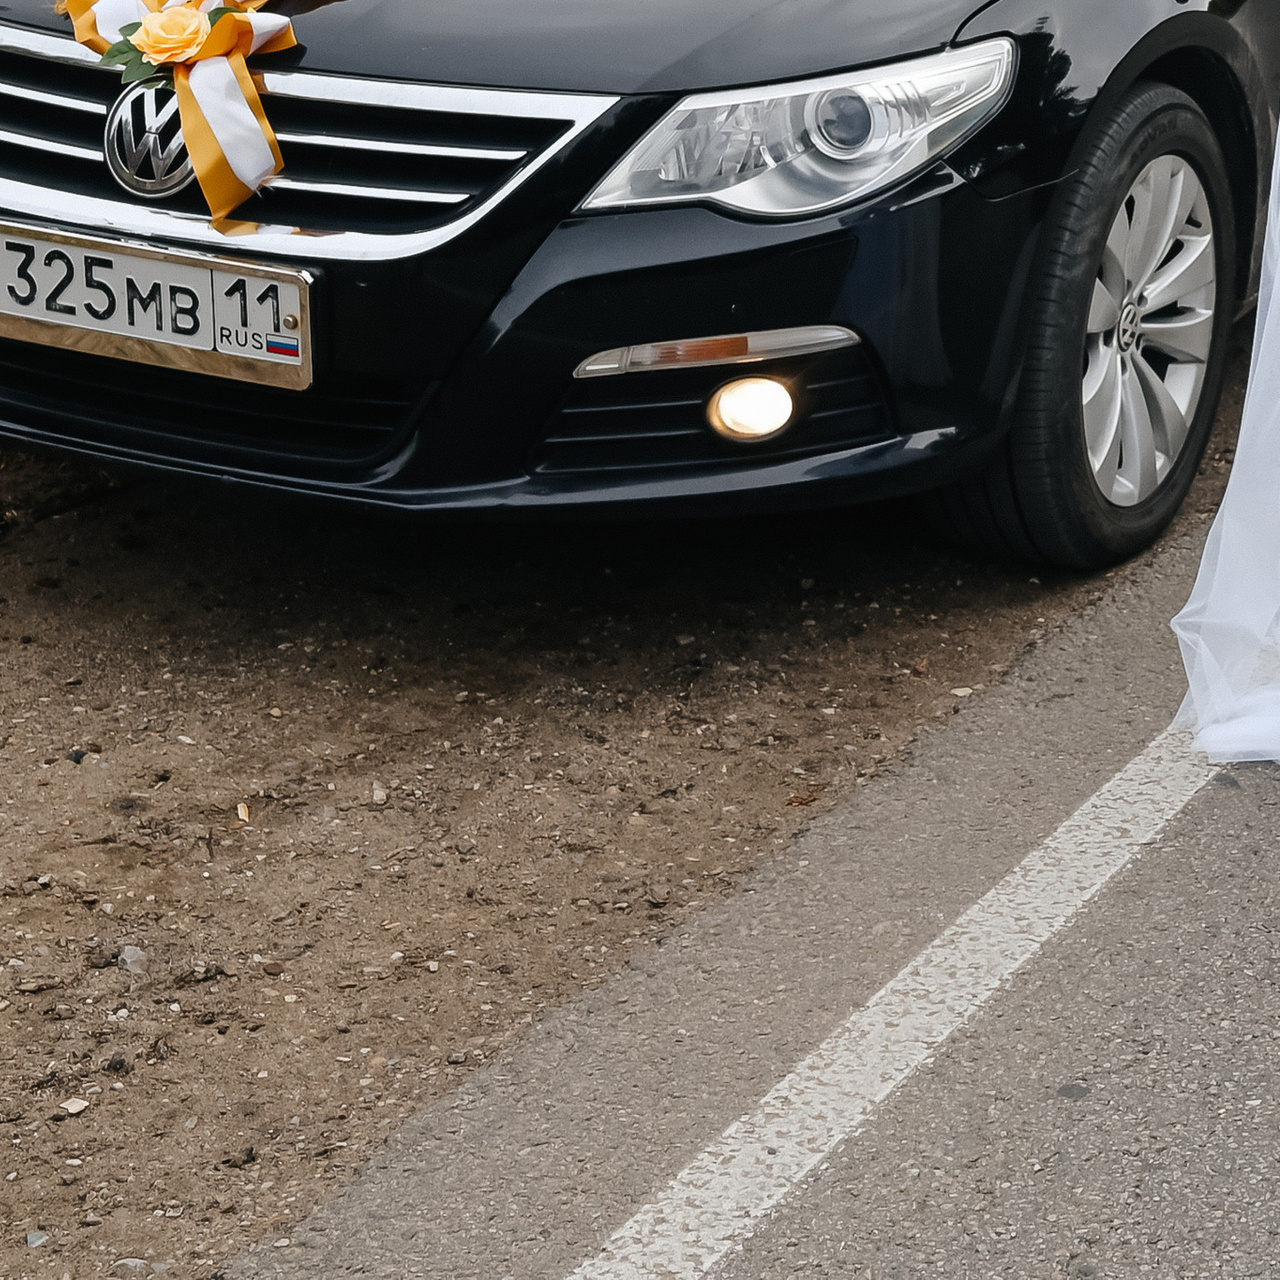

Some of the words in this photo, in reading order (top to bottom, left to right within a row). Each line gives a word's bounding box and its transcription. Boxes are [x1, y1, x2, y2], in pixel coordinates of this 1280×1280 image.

[110, 80, 190, 186] VW
[5, 240, 201, 336] 325MB
[224, 278, 281, 333] 11
[220, 326, 264, 350] RUS
